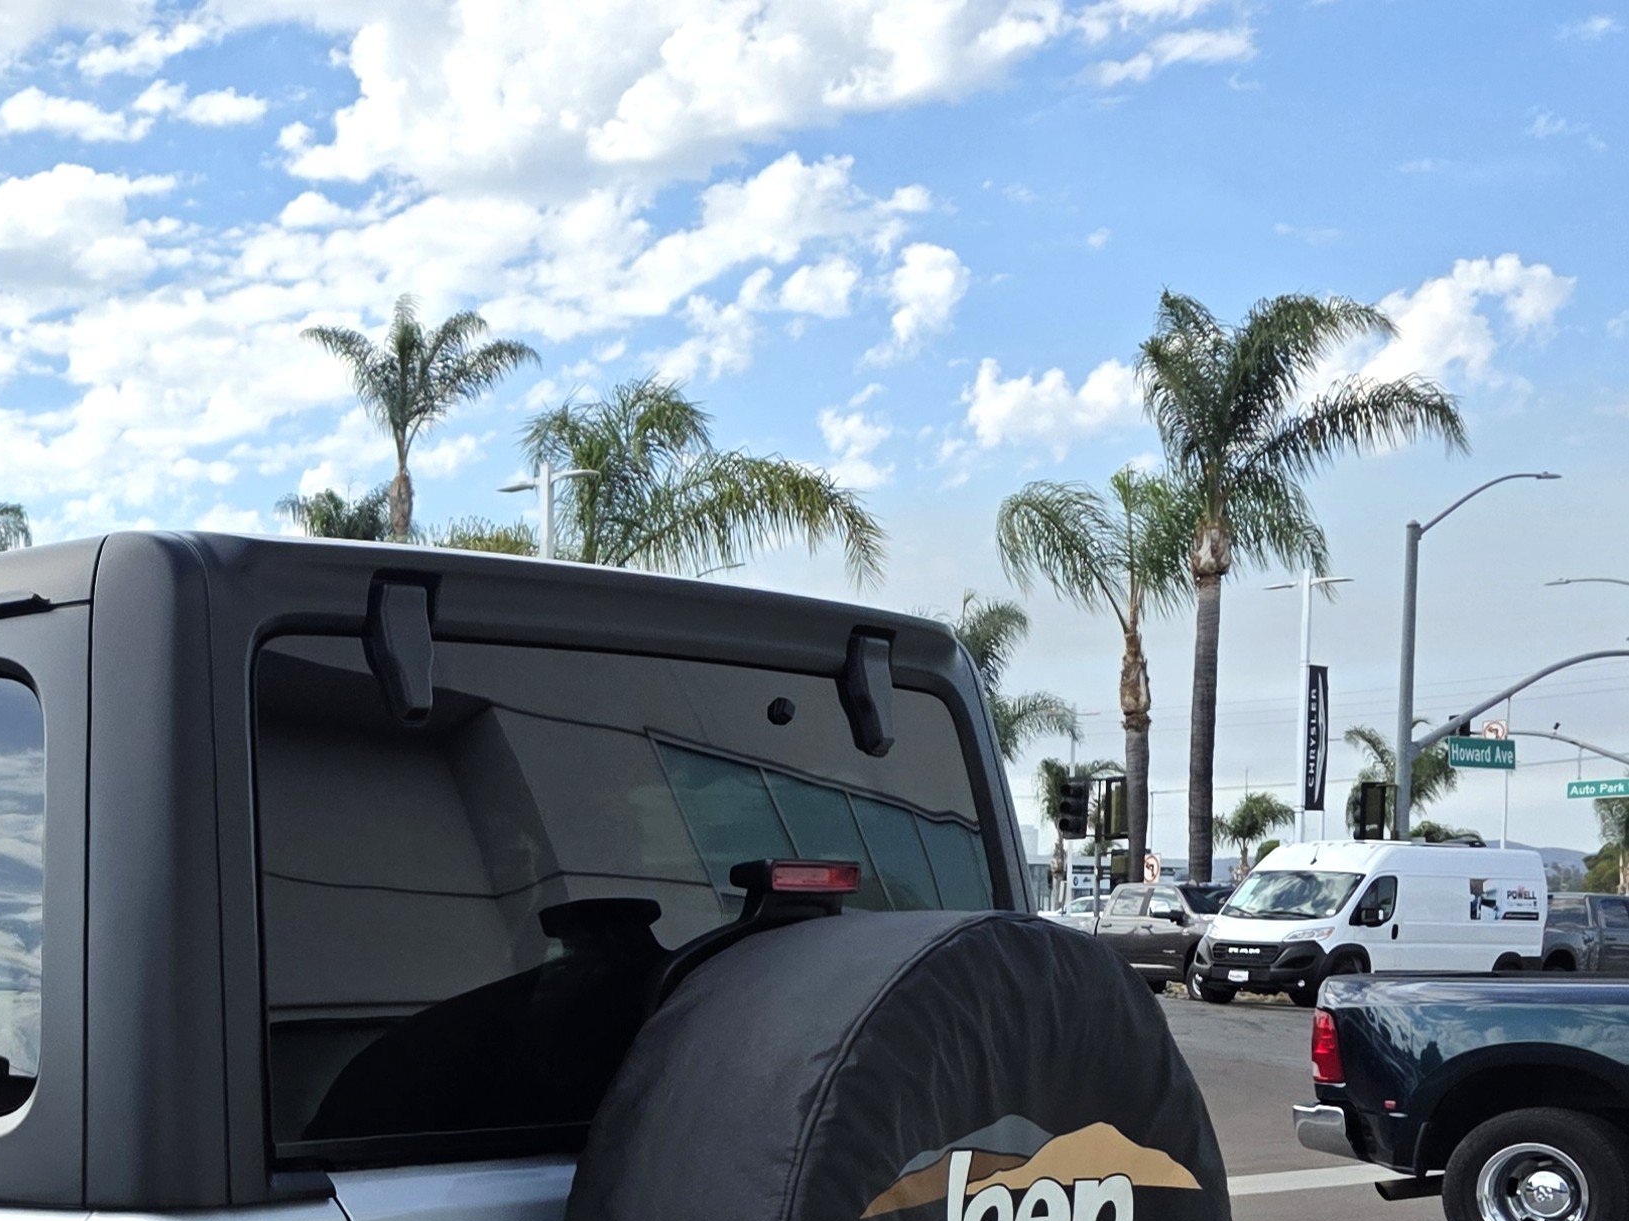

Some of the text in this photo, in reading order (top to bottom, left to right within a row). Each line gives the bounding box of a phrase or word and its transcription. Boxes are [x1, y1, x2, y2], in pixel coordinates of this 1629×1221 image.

[1308, 688, 1317, 787] CHRYSLER
[1451, 743, 1514, 764] Howard Ave
[1569, 784, 1596, 796] Auto
[1599, 782, 1625, 794] Park
[1506, 890, 1537, 900] POWELL
